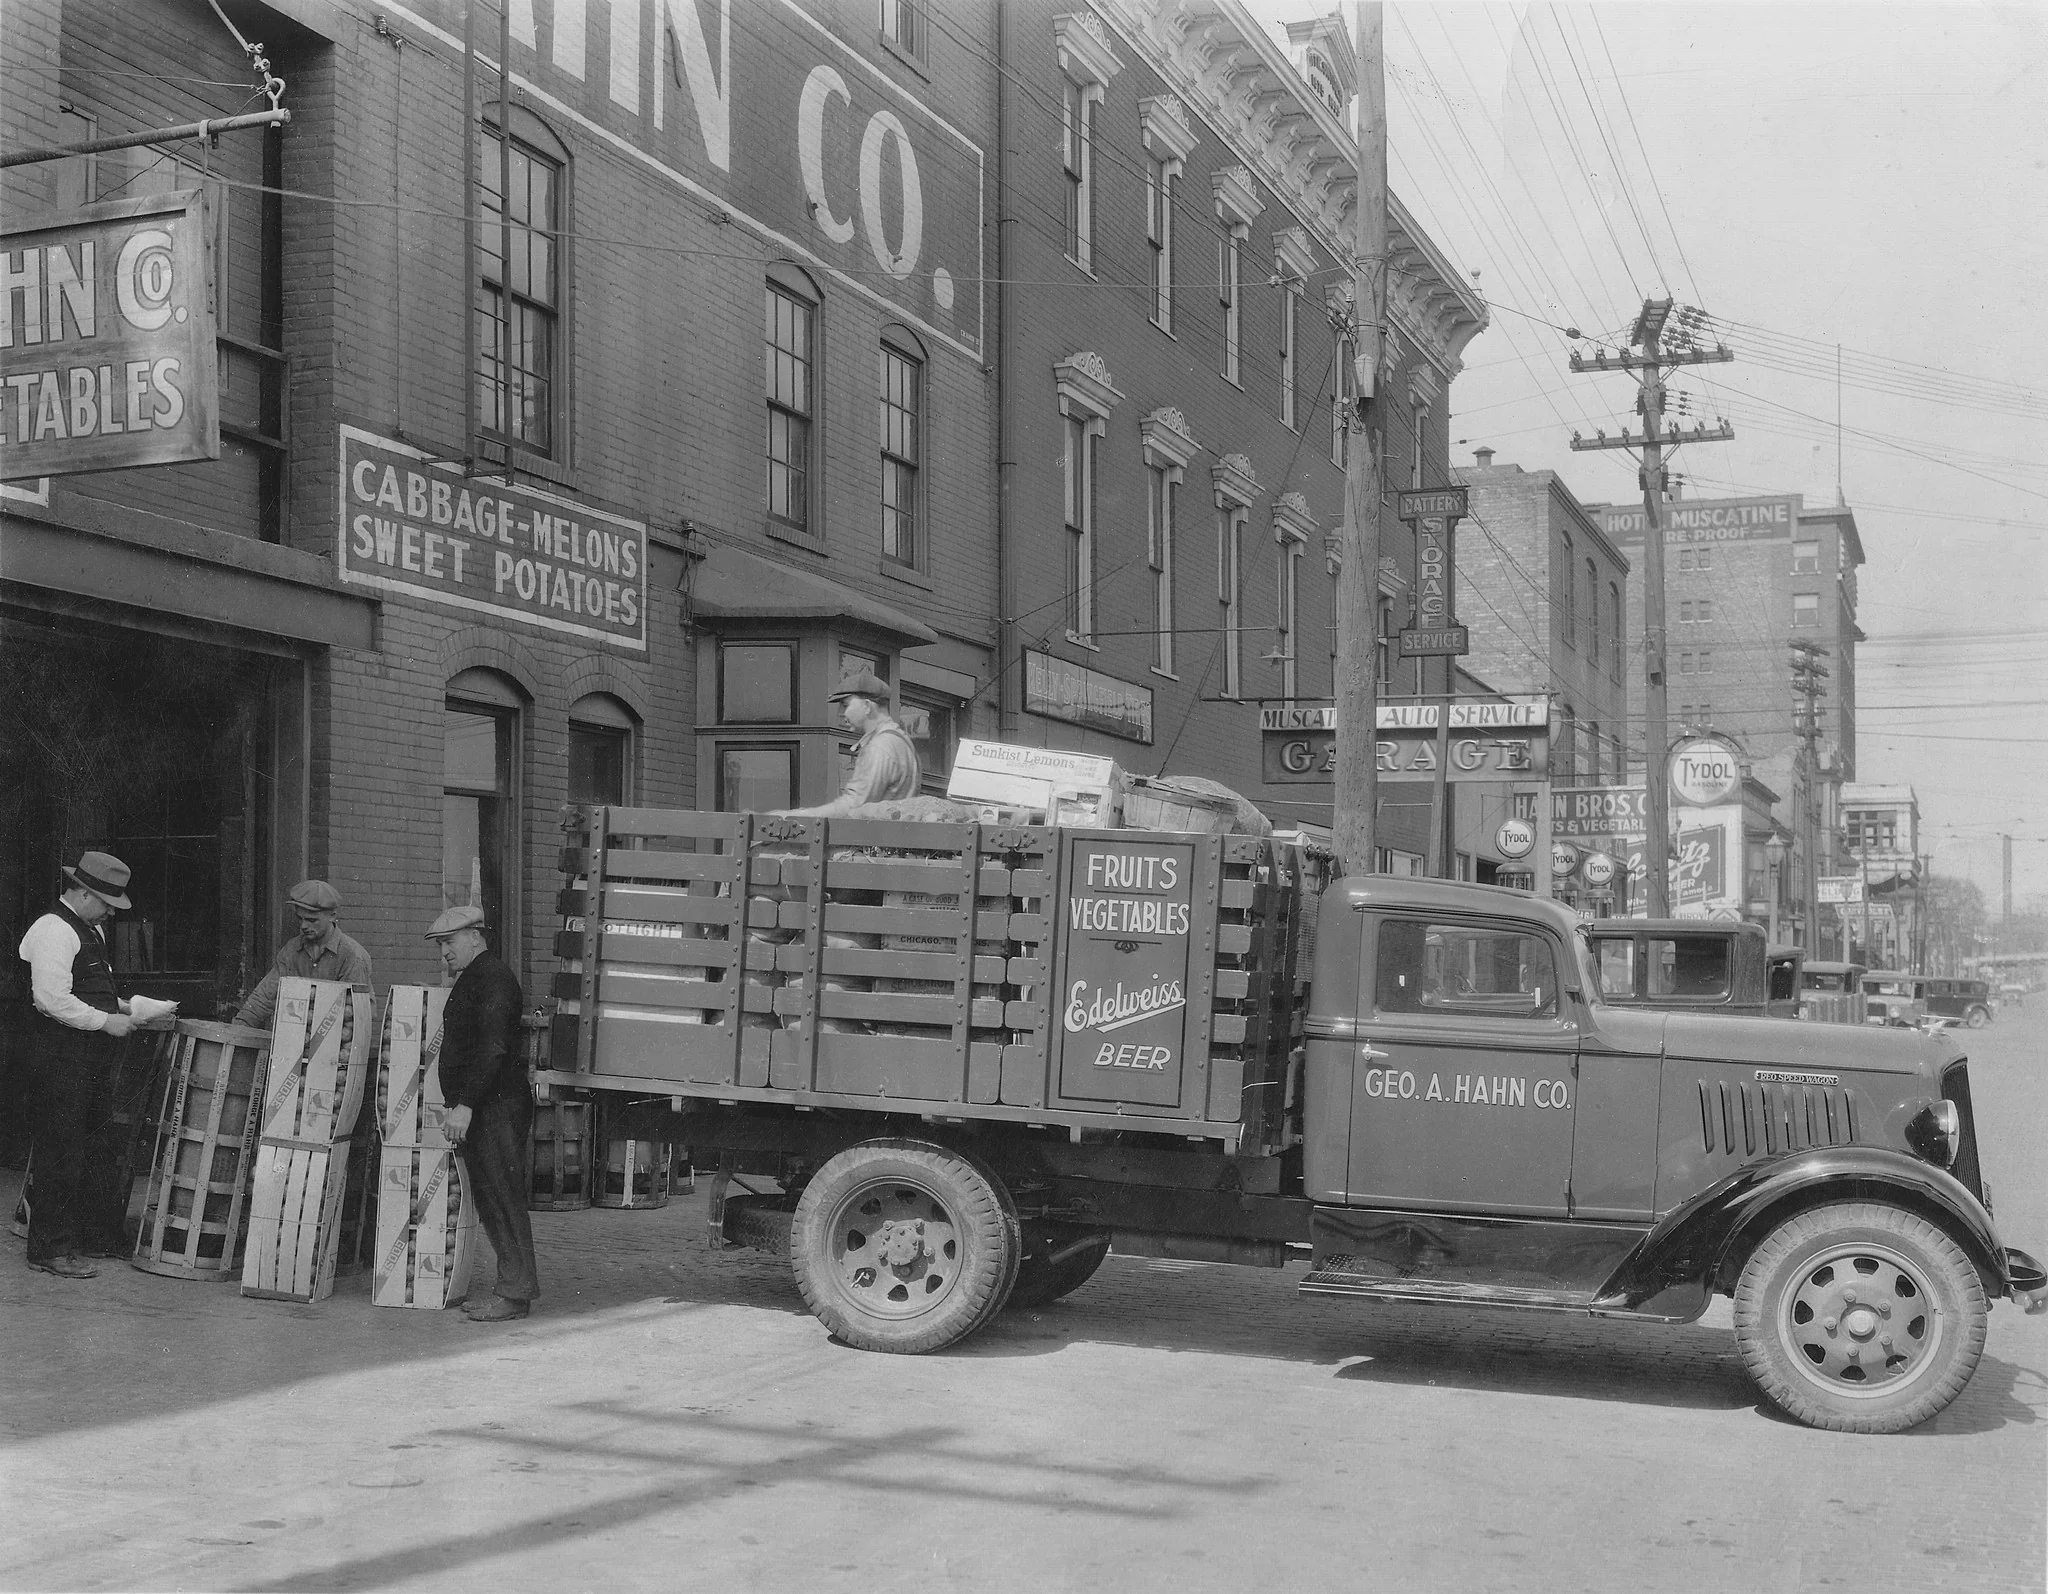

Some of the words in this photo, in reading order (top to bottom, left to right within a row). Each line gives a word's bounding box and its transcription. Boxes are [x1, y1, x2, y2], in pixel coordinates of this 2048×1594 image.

[799, 64, 955, 310] CO.
[0, 357, 185, 444] TABLES
[352, 459, 638, 580] CABBAGE-MELONS
[1404, 494, 1461, 514] BATTERY
[1607, 513, 1667, 533] HOT
[1671, 504, 1789, 528] MUSCATINE
[1665, 526, 1750, 543] RE-PROOF
[352, 514, 471, 583] SWEET
[494, 550, 638, 626] POTATOES
[1421, 517, 1444, 629] STORAGE
[1404, 632, 1461, 650] SERVICE
[1262, 708, 1337, 729] MUSCAT
[1382, 706, 1439, 727] AUTO
[1452, 704, 1538, 725] SERVICE
[972, 744, 1021, 761] Sunkist
[1023, 751, 1076, 769] Lemons
[1515, 794, 1567, 819] HAN
[1575, 793, 1635, 818] BROS.
[1581, 818, 1647, 833] VEGETABL
[1087, 853, 1178, 890] FRUITS
[1070, 898, 1190, 935] VEGETABLES
[1064, 973, 1186, 1033] Edelweiss
[1093, 1042, 1171, 1070] BEER
[271, 1071, 299, 1110] GOOSE
[1364, 1068, 1421, 1100] GEO.
[1424, 1072, 1451, 1102] A.
[1454, 1074, 1526, 1107] HAHN
[1532, 1079, 1572, 1109] CO.
[1760, 1072, 1778, 1081] REO
[1778, 1073, 1805, 1082] SPEED
[1806, 1075, 1835, 1084] WAGON
[423, 1167, 445, 1202] BLUE
